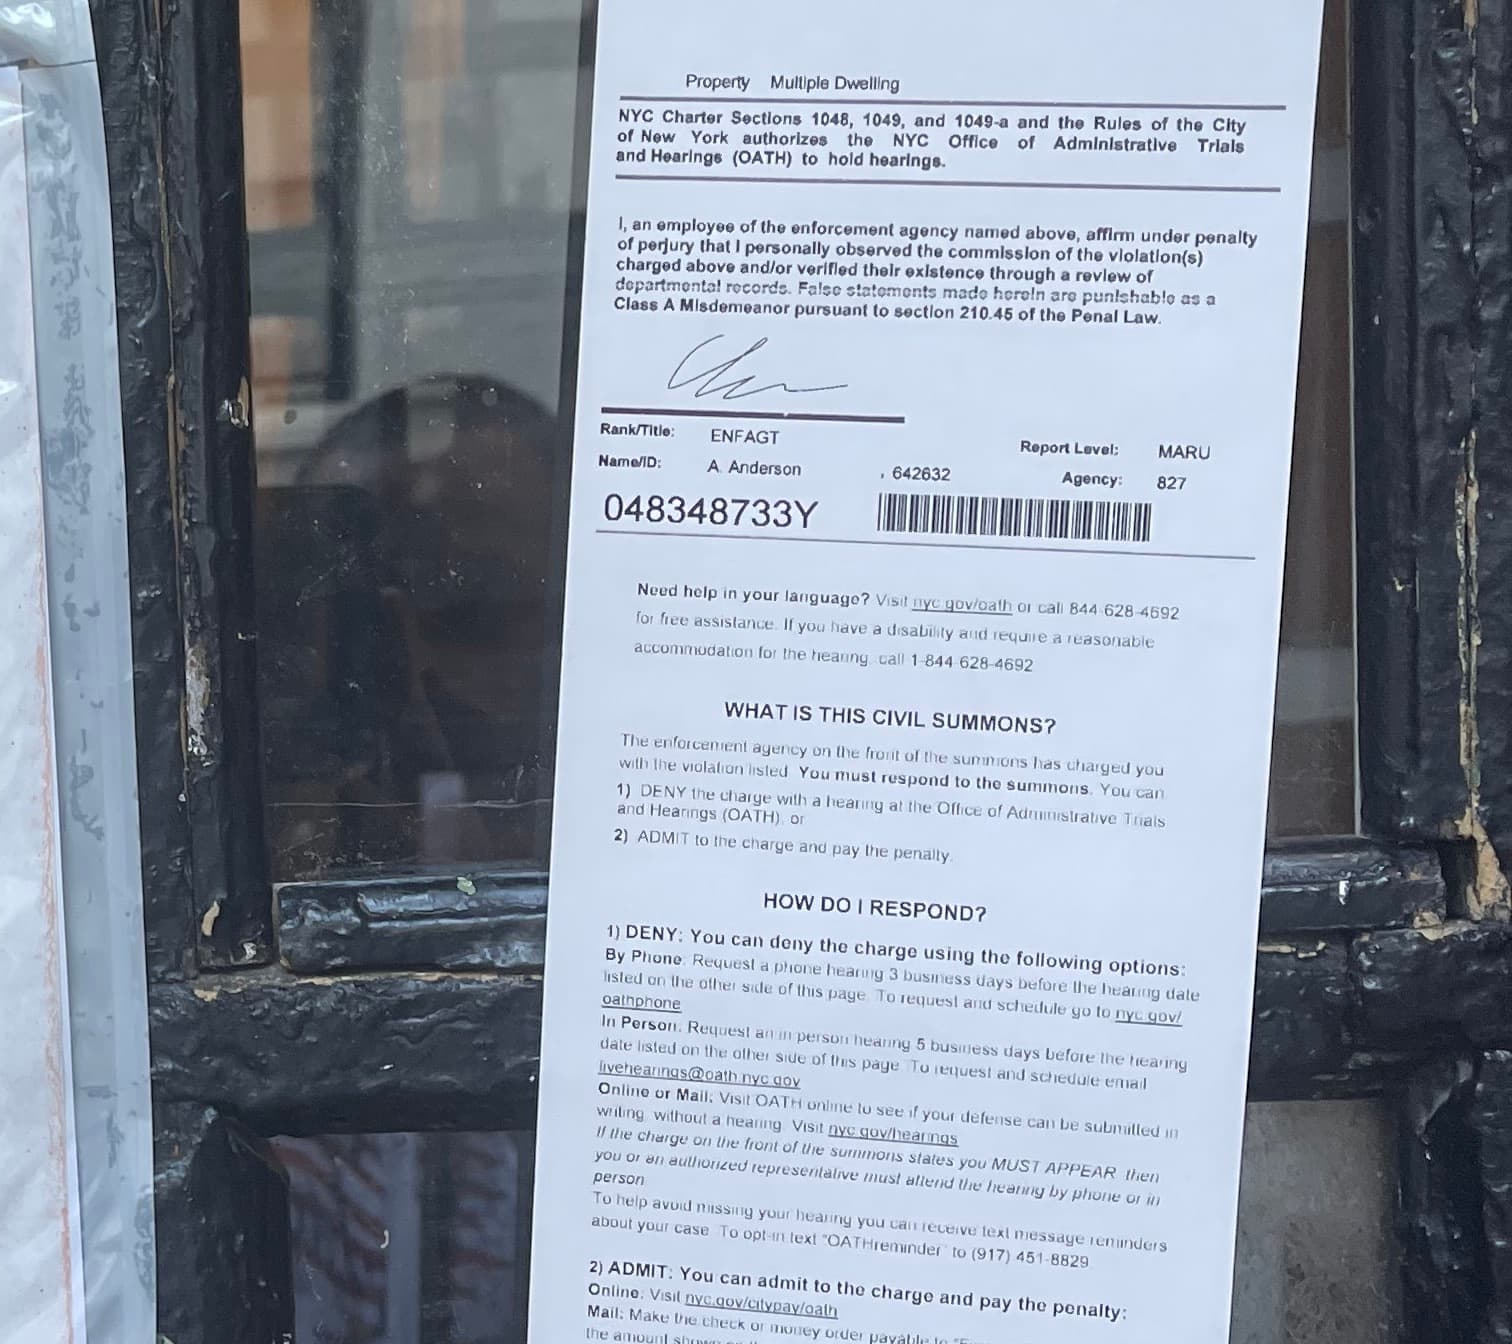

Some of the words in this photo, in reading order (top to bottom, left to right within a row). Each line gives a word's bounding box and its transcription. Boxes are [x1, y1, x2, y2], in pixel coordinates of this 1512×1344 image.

[685, 73, 750, 92] Property
[770, 74, 829, 93] Multiple
[834, 75, 899, 94] Dwelling
[711, 428, 779, 444] ENFAGT
[1020, 439, 1070, 456] Report
[1074, 441, 1118, 455] Level:
[1158, 444, 1210, 460] MARU
[598, 454, 661, 468] Name/ID:
[892, 465, 950, 481] 642632
[1061, 471, 1122, 488] Agency:
[1156, 475, 1186, 490] 827
[604, 493, 818, 528] 048348733Y
[724, 701, 788, 720] WHAT
[793, 704, 812, 721] IS
[818, 706, 865, 723] THIS
[872, 709, 925, 727] CIVIL
[932, 712, 1056, 734] SUMMONS?
[764, 892, 814, 911] HOW
[820, 895, 850, 913] DO
[858, 898, 862, 914] I
[870, 899, 986, 922] RESPOND?
[589, 1260, 602, 1276] 2)
[679, 1265, 713, 1282] You
[719, 1273, 751, 1286] can
[757, 1274, 807, 1291] admit
[814, 1279, 830, 1293] to
[837, 1281, 865, 1296] the
[871, 1284, 933, 1305] charge
[939, 1292, 973, 1306] and
[979, 1296, 1011, 1312] pay
[1018, 1296, 1046, 1312] the
